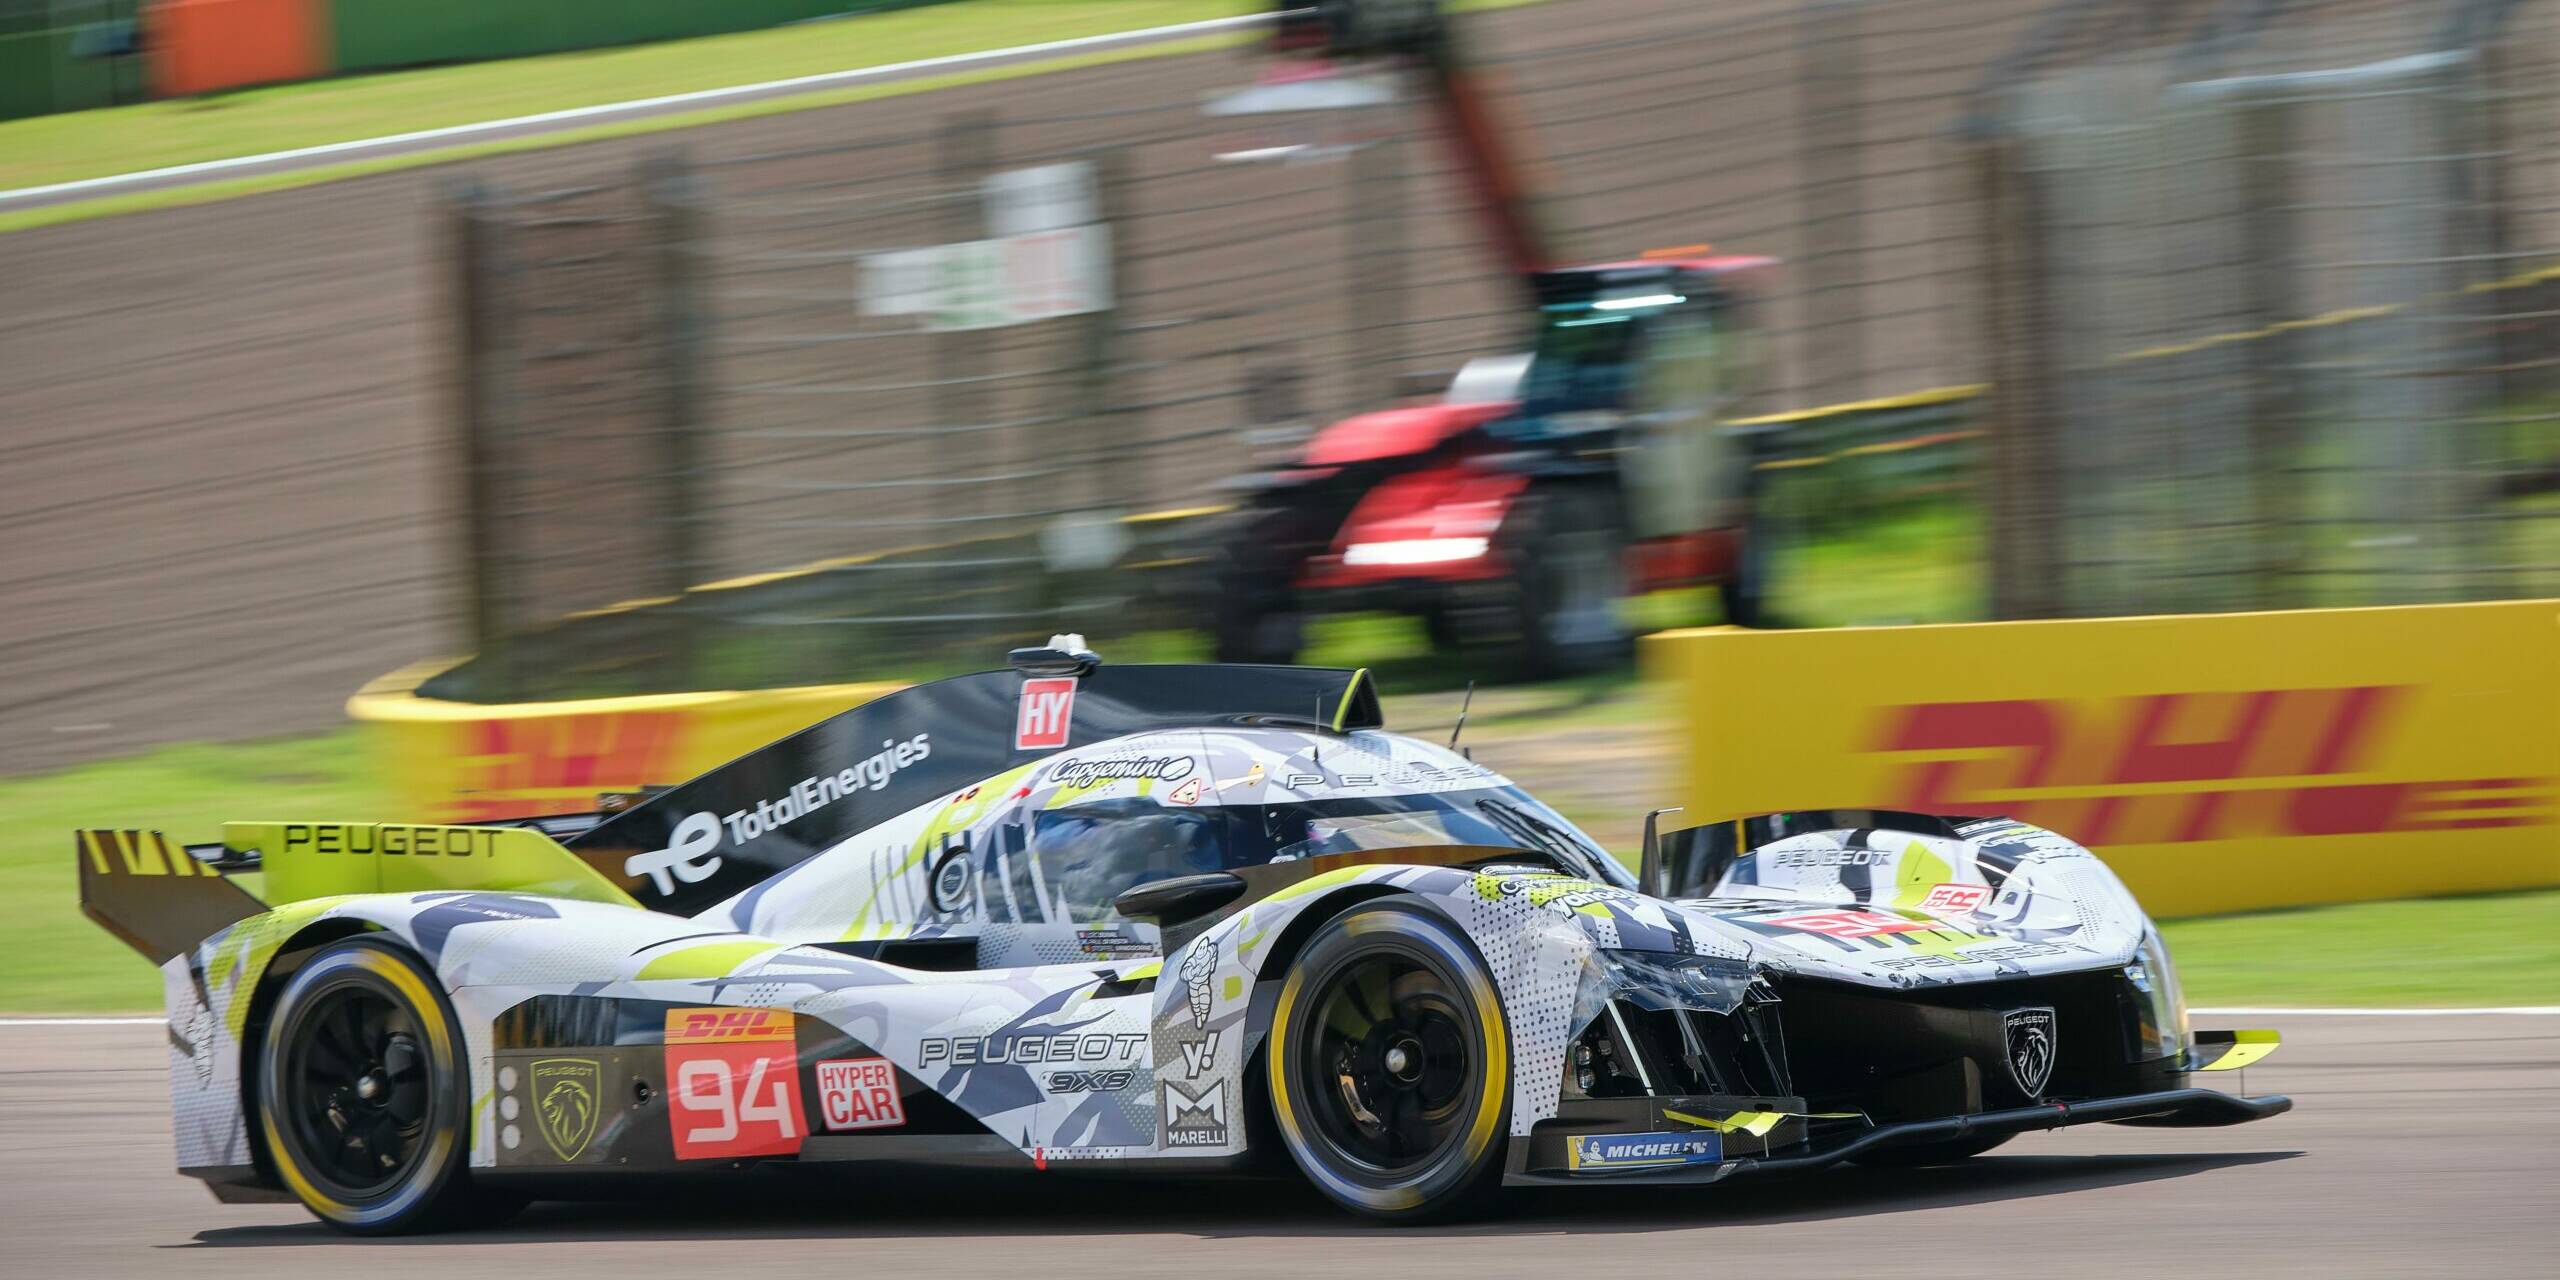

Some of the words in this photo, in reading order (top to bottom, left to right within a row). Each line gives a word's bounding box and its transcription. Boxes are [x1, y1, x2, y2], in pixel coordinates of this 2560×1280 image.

[1023, 691, 1071, 736] HY
[1051, 755, 1171, 789] Capgemini
[1855, 684, 2430, 848] DHL
[722, 732, 932, 846] TotalEnergies
[284, 823, 504, 858] PEUGEOT
[1773, 848, 1893, 868] PEUGEOT
[1871, 942, 2095, 971] PEUGEOT
[684, 1011, 777, 1037] DHL
[2007, 1015, 2050, 1028] PEUGEOT
[918, 1033, 1149, 1069] PEUGEOT
[535, 1065, 594, 1077] PEUGEOT
[823, 1064, 889, 1090] HYPER
[1047, 1069, 1135, 1093] 9X8
[677, 1057, 797, 1143] 94
[826, 1087, 898, 1125] CAR
[1168, 1130, 1226, 1145] MARELLI
